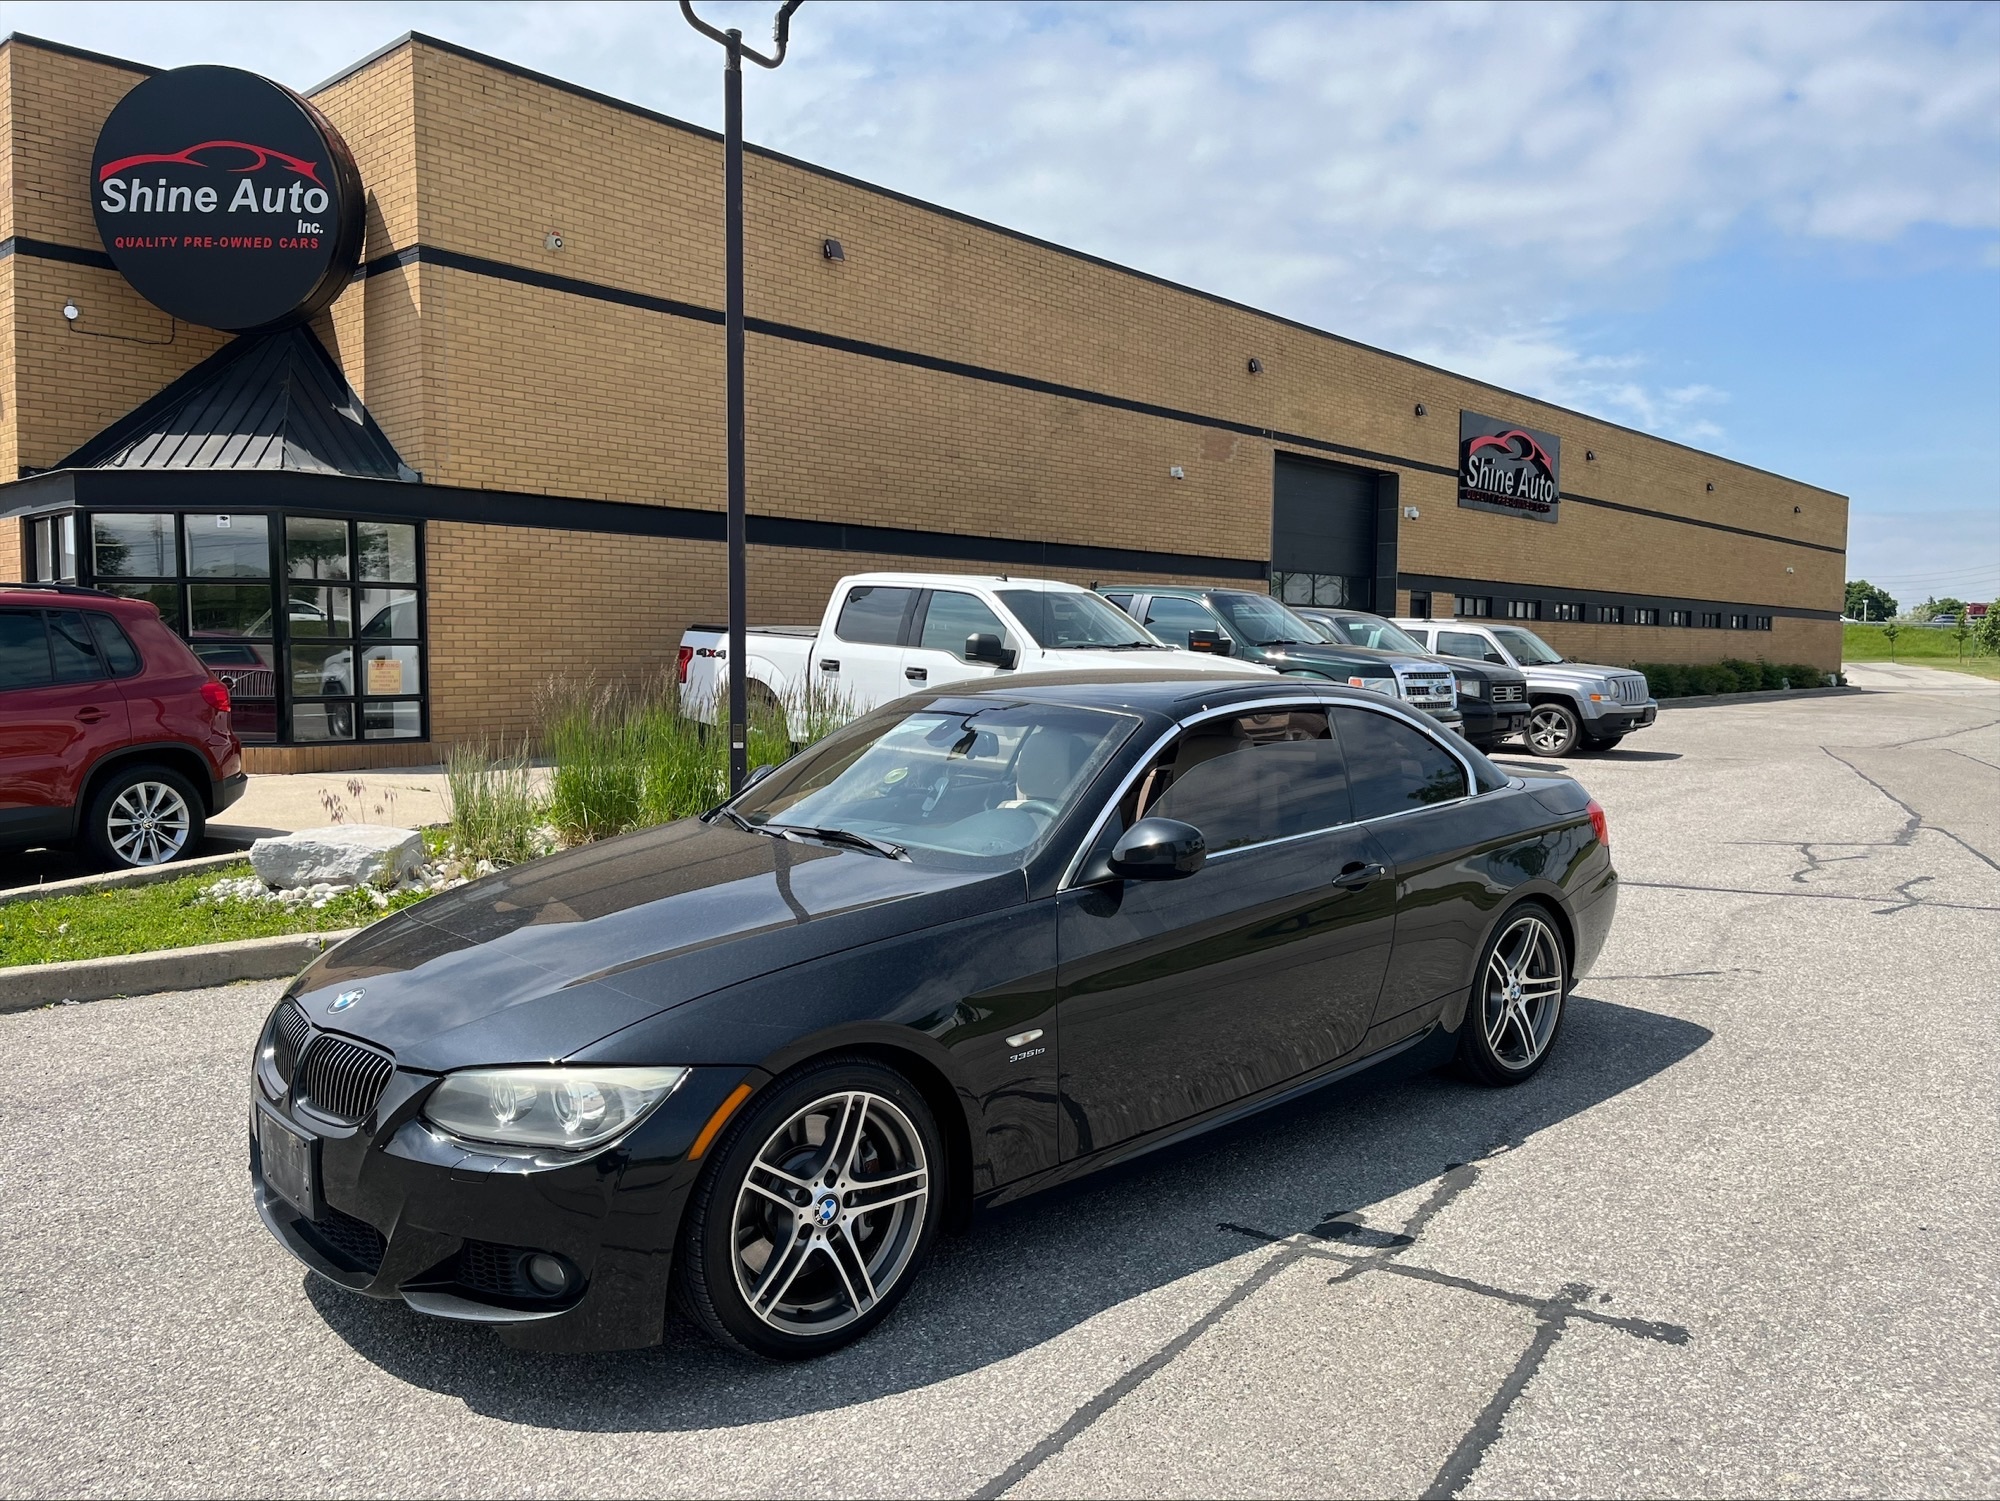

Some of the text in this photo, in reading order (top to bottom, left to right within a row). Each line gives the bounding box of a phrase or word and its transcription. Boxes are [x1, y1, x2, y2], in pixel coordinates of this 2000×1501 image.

[100, 178, 329, 214] Shine Auto
[297, 219, 324, 234] Inc.
[115, 236, 319, 249] QUALITY PRE-OWNED CARS
[1466, 455, 1553, 502] Shine Auto
